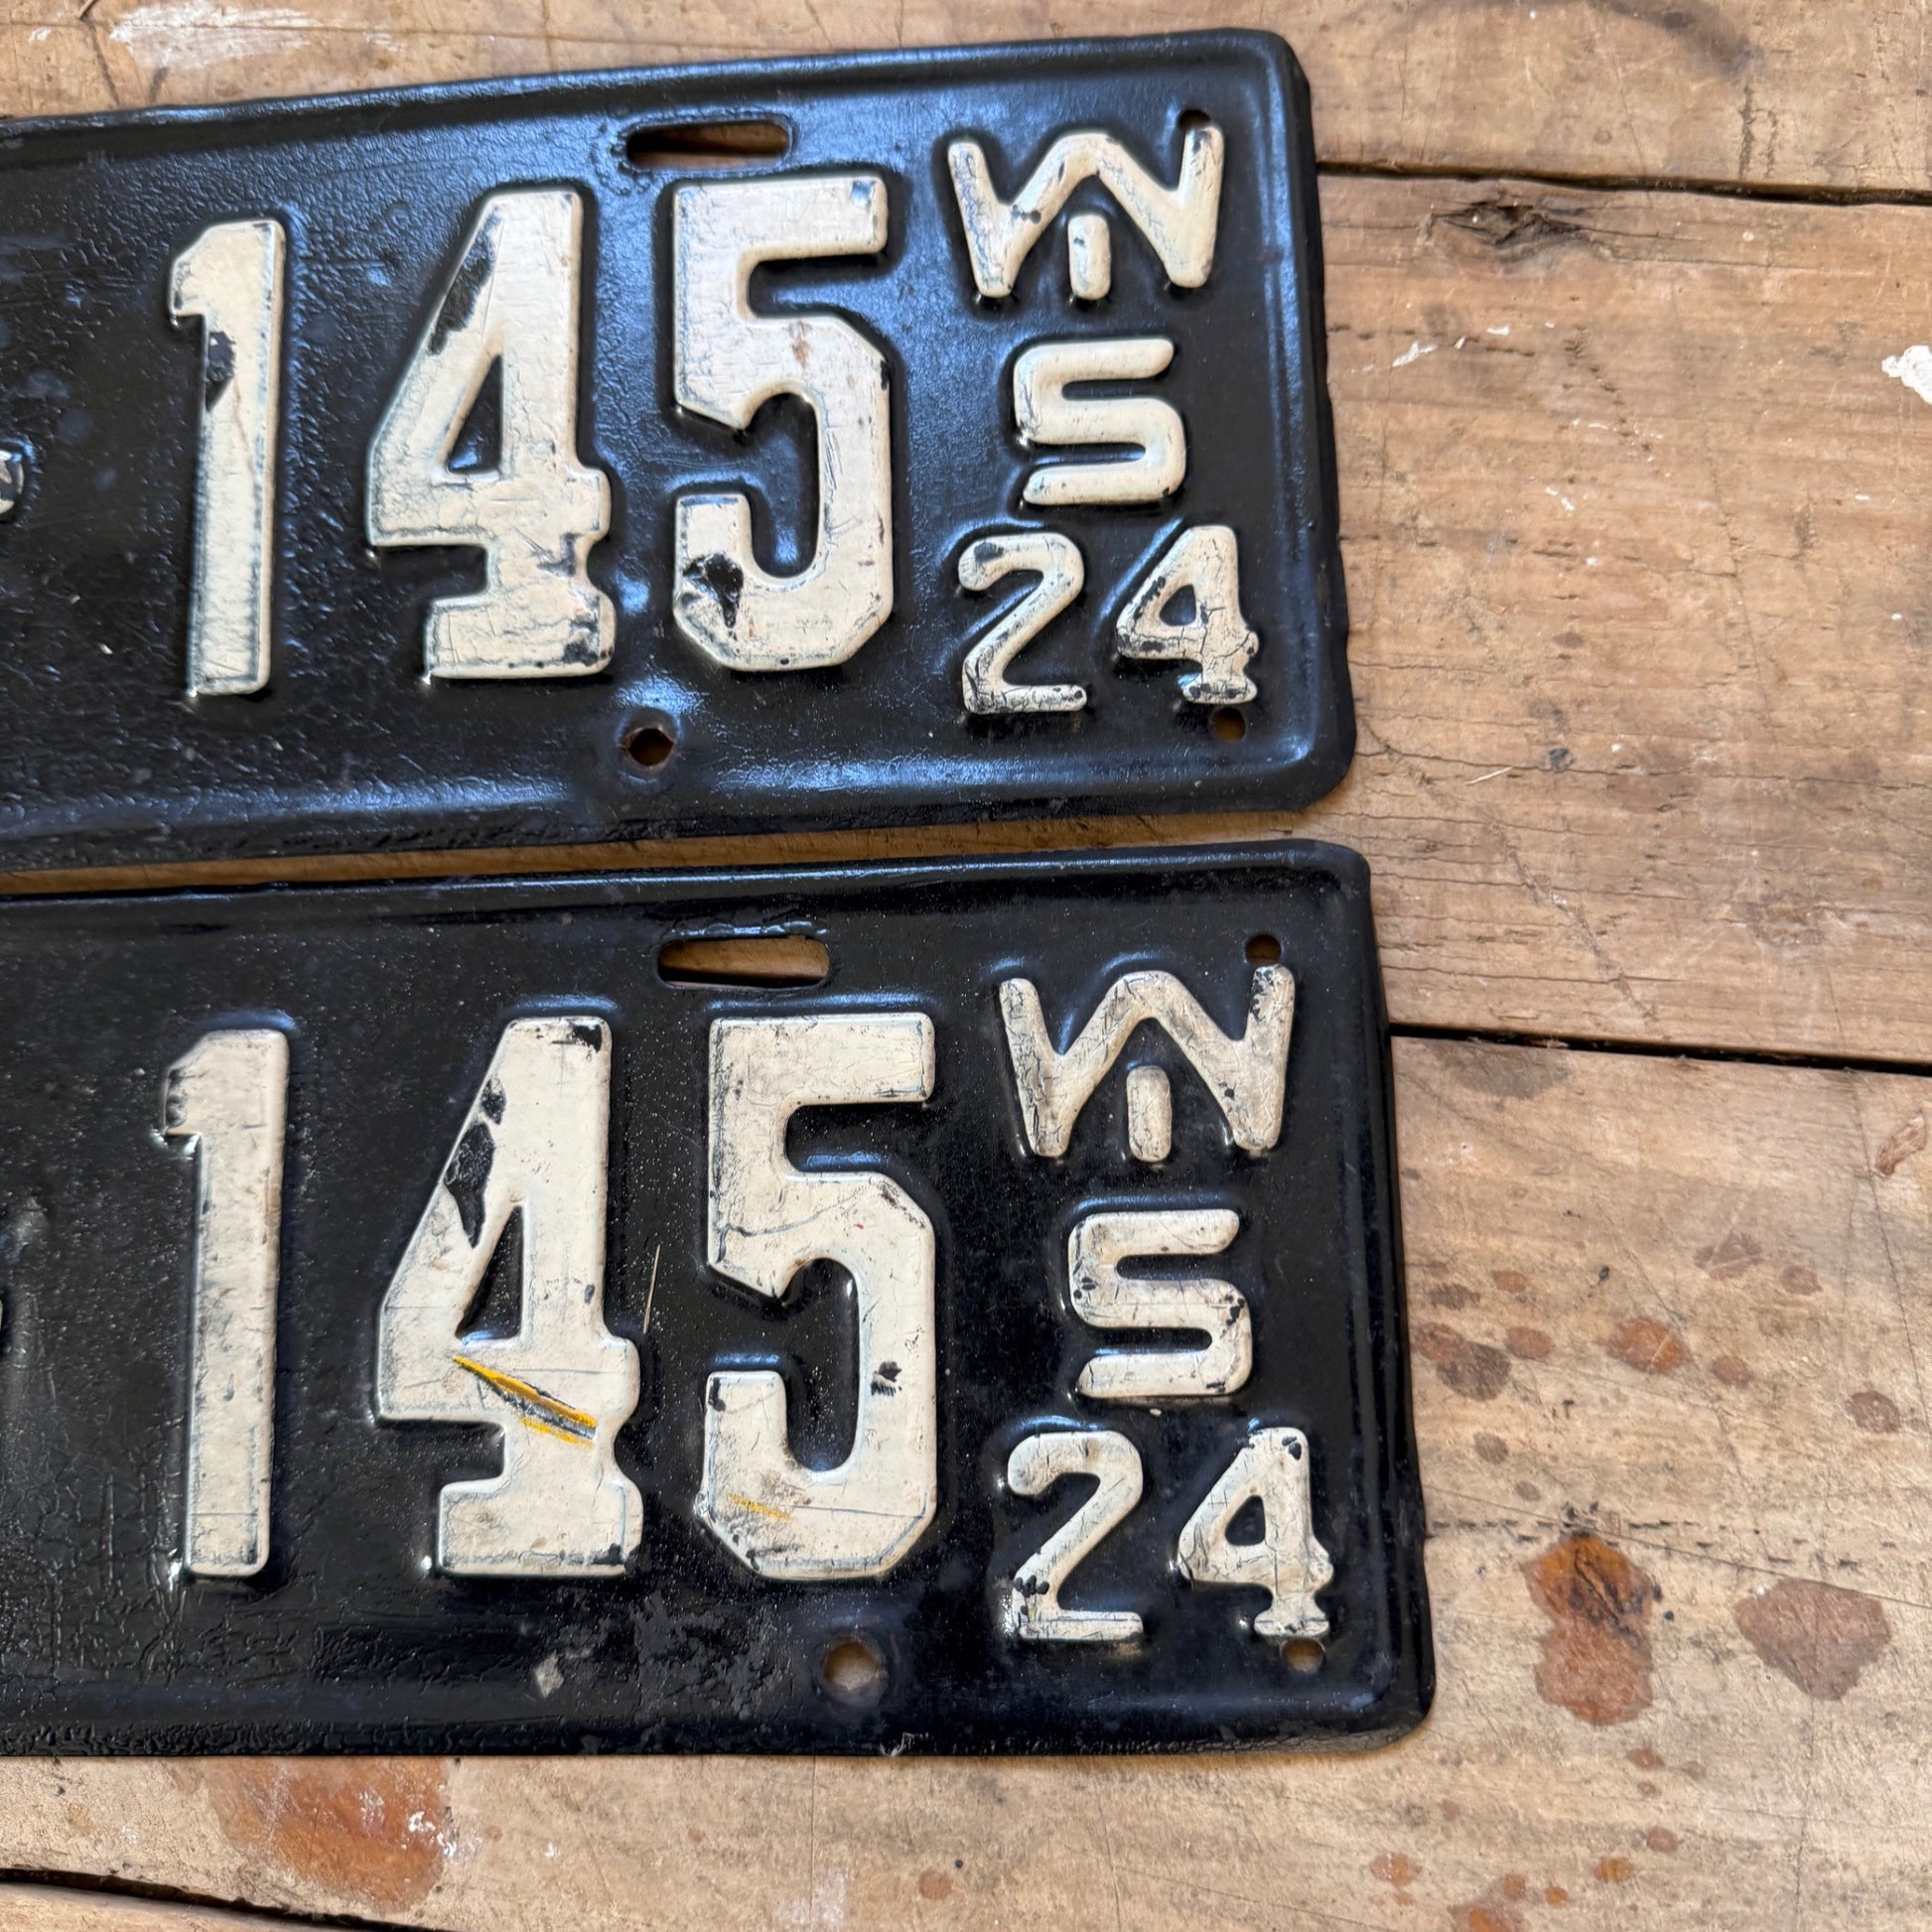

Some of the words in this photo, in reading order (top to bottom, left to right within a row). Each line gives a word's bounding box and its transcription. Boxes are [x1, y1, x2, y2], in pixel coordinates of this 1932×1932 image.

[169, 175, 894, 697] 145
[957, 524, 1261, 716] 24
[162, 1010, 937, 1581] 145
[1005, 1426, 1334, 1639] 24
